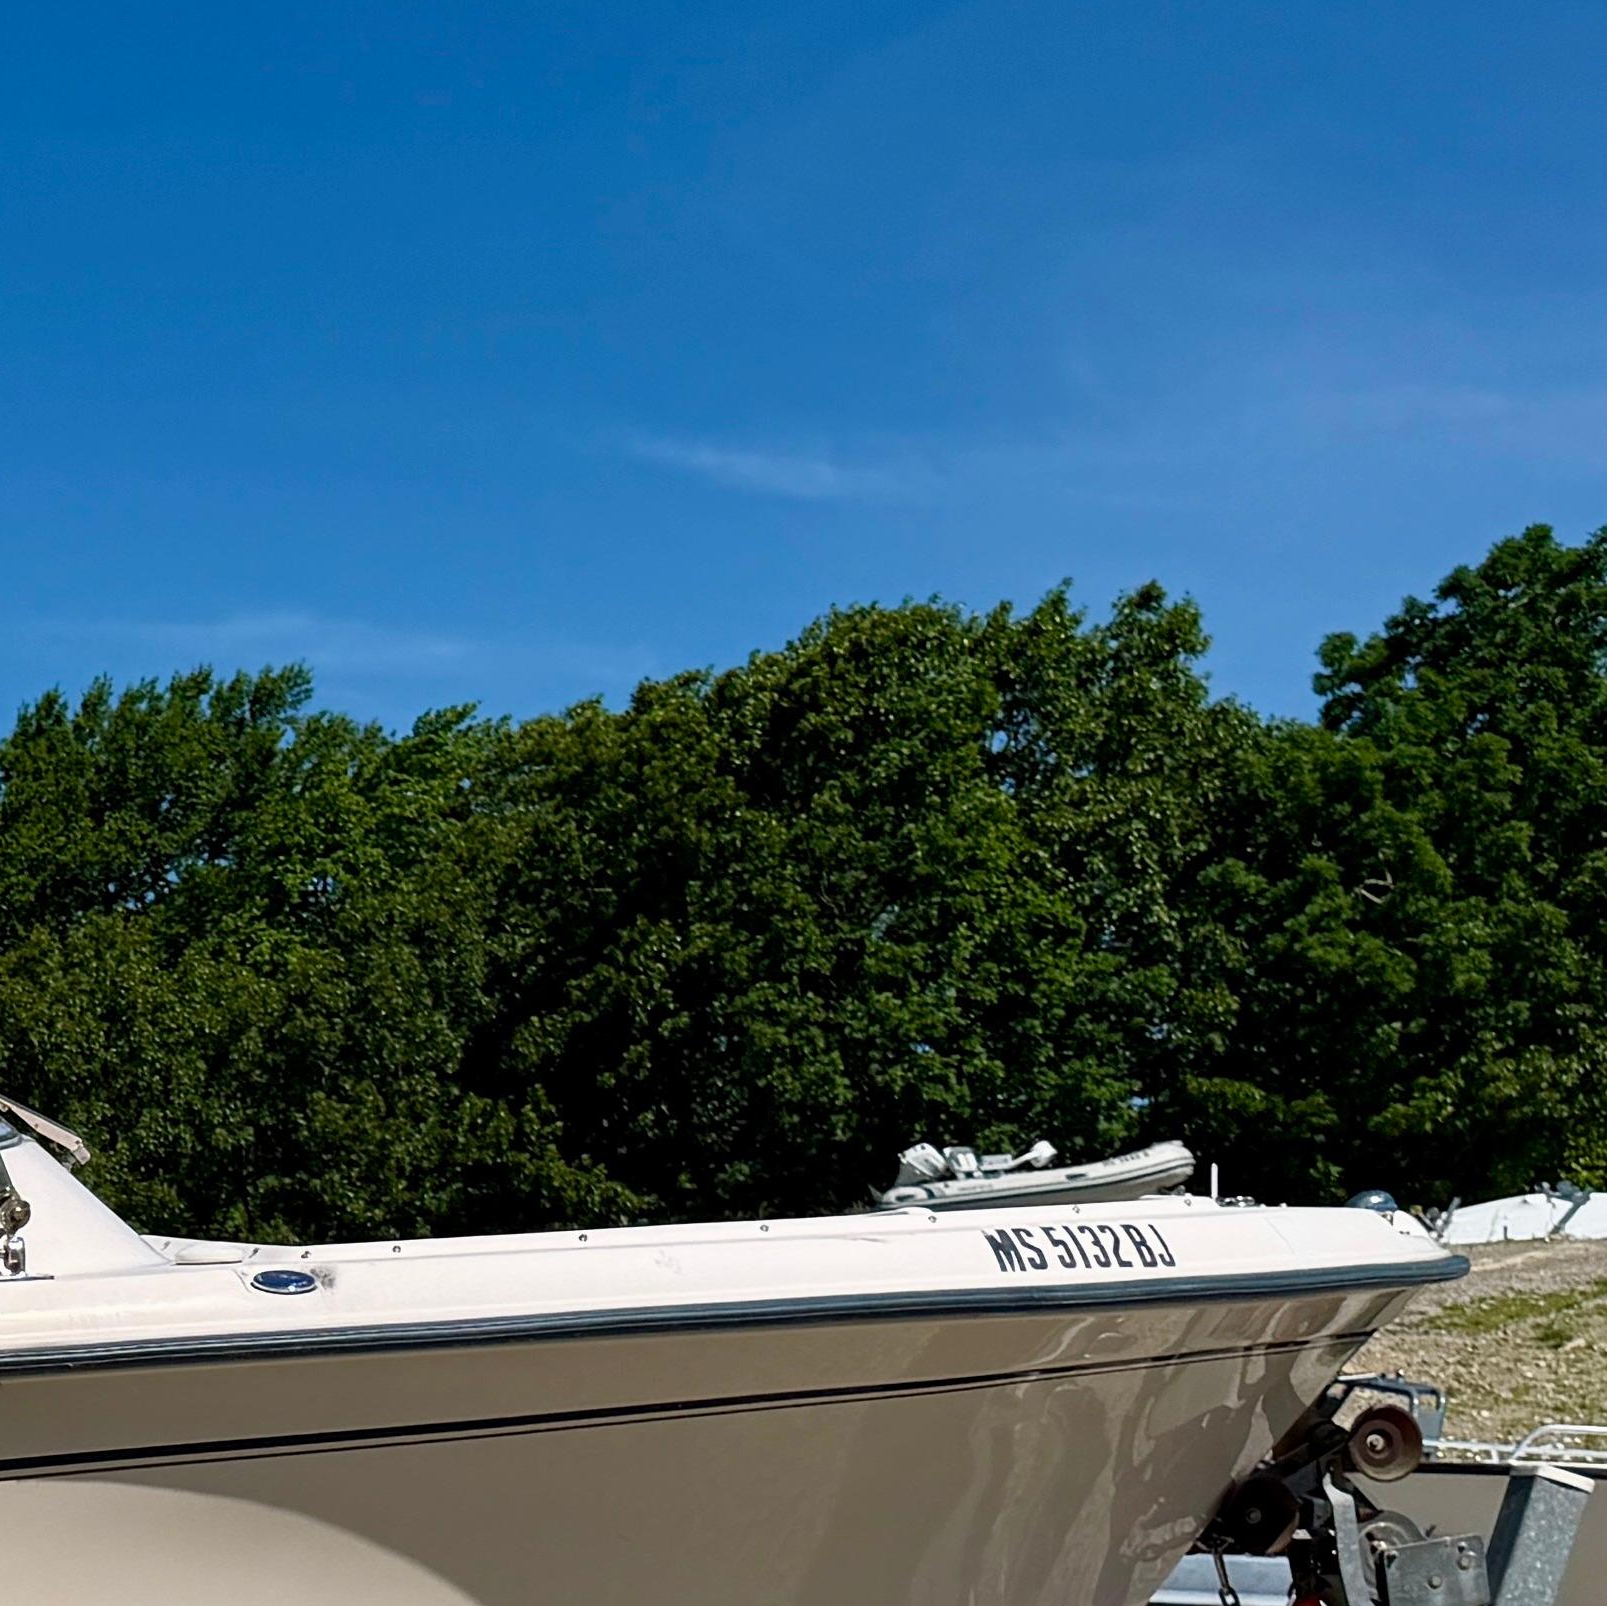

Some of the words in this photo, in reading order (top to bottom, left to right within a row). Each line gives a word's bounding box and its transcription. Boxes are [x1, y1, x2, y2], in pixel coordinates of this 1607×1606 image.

[983, 1227, 1049, 1273] MS
[1039, 1224, 1134, 1270] 5132
[1120, 1223, 1177, 1268] BJ
